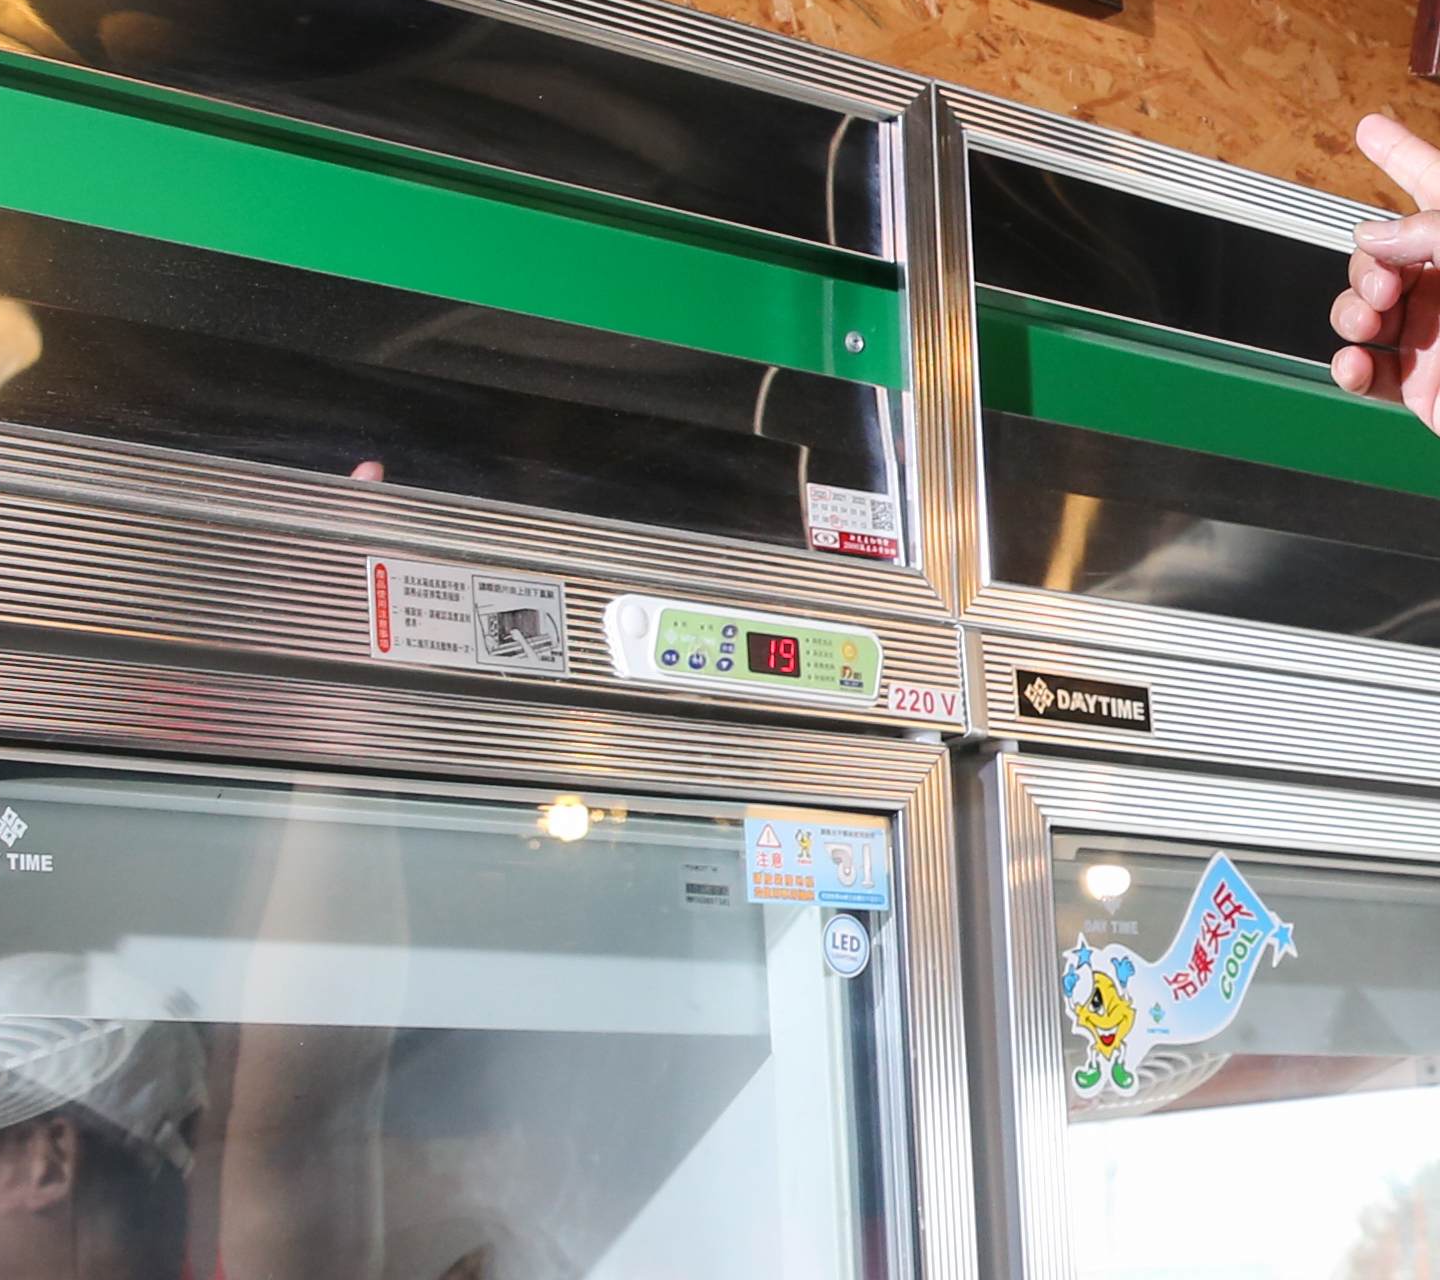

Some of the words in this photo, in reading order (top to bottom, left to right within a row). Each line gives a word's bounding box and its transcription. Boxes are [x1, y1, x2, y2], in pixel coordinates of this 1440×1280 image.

[767, 638, 796, 673] 19
[894, 687, 935, 714] 220
[941, 693, 957, 716] V
[1056, 689, 1146, 721] DAYTIME
[6, 853, 54, 872] TIME
[756, 851, 783, 869] 注意
[831, 932, 861, 952] LED
[1162, 880, 1257, 1001] 冷凍尖兵
[1221, 930, 1261, 1001] COOL
